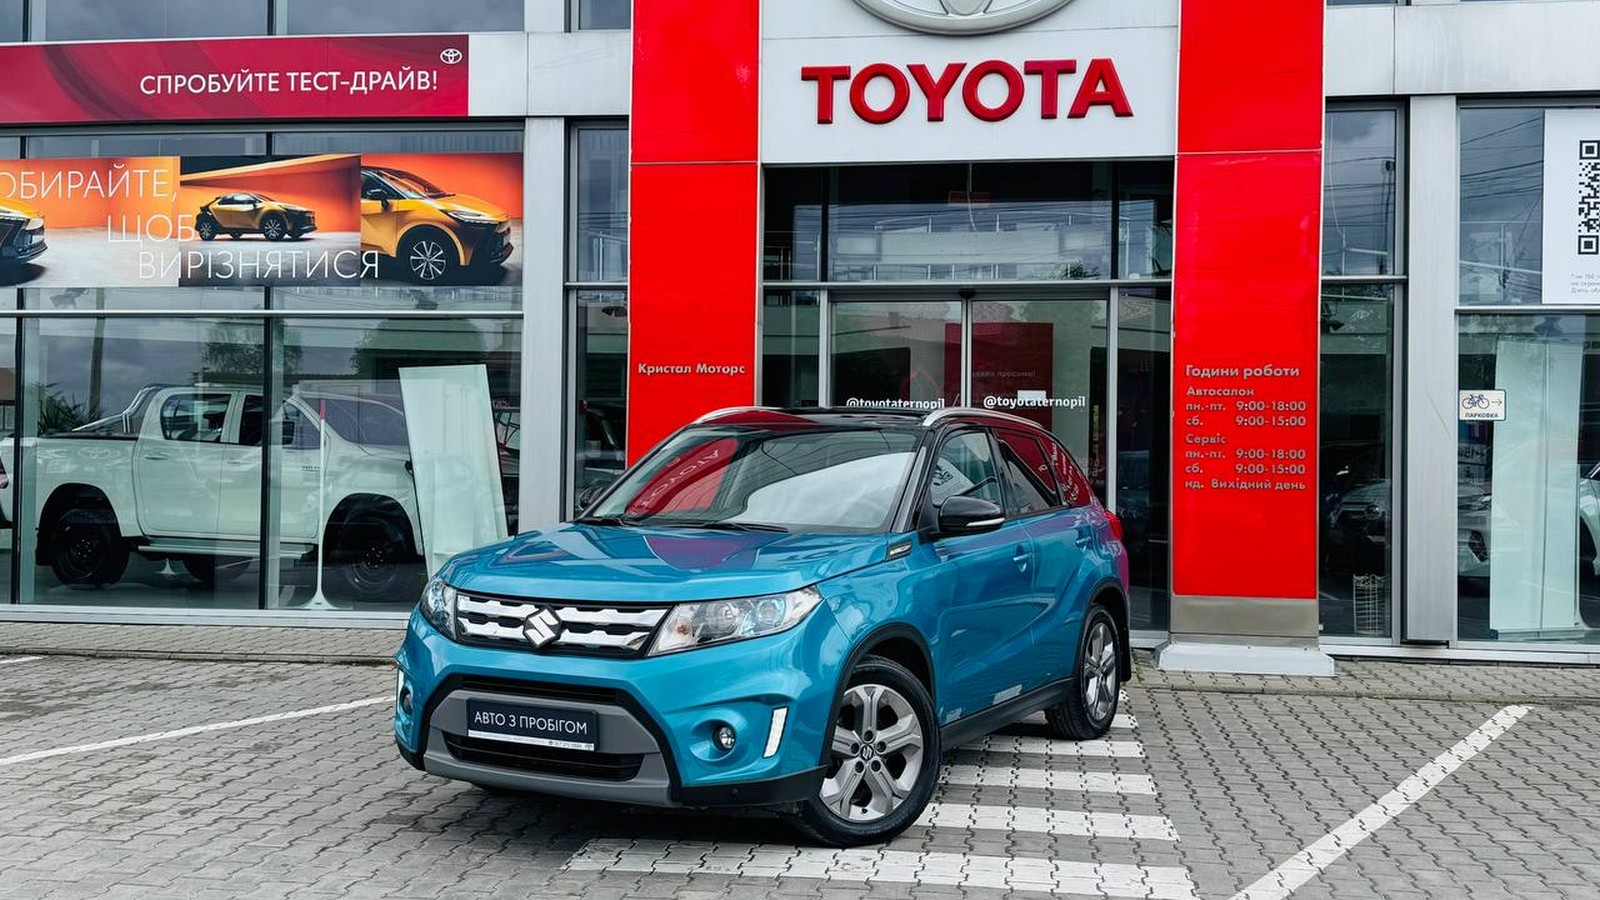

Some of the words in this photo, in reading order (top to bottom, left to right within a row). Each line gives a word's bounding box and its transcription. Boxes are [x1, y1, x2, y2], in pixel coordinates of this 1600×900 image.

[140, 68, 280, 95] СПРОБУЙТЕ
[286, 66, 438, 95] ТЕСТ-ДРАЙВ!
[801, 58, 1134, 124] TOYOTA
[107, 213, 195, 249] ЩОБ
[138, 250, 380, 280] ВИРІЗНЯТИСЯ
[638, 363, 692, 376] Кристал
[696, 363, 746, 376] Моторс
[1185, 364, 1240, 378] Години
[1243, 363, 1300, 380] роботи
[1186, 385, 1255, 396] Автосалон
[983, 395, 1086, 409] @toyotaternopil
[1185, 403, 1226, 411] пн.-пт.
[1236, 401, 1306, 411] 9:00-18:00
[1185, 415, 1204, 426] сб.
[1236, 416, 1306, 426] 9:00-15:00
[1185, 433, 1227, 446] Сервіс
[1185, 463, 1203, 474] сб.
[1185, 480, 1205, 489] нд.
[1211, 478, 1272, 489] Вихідний
[1275, 482, 1306, 490] день
[474, 711, 506, 726] АВТО
[519, 715, 588, 735] ПРОБІГОМ
